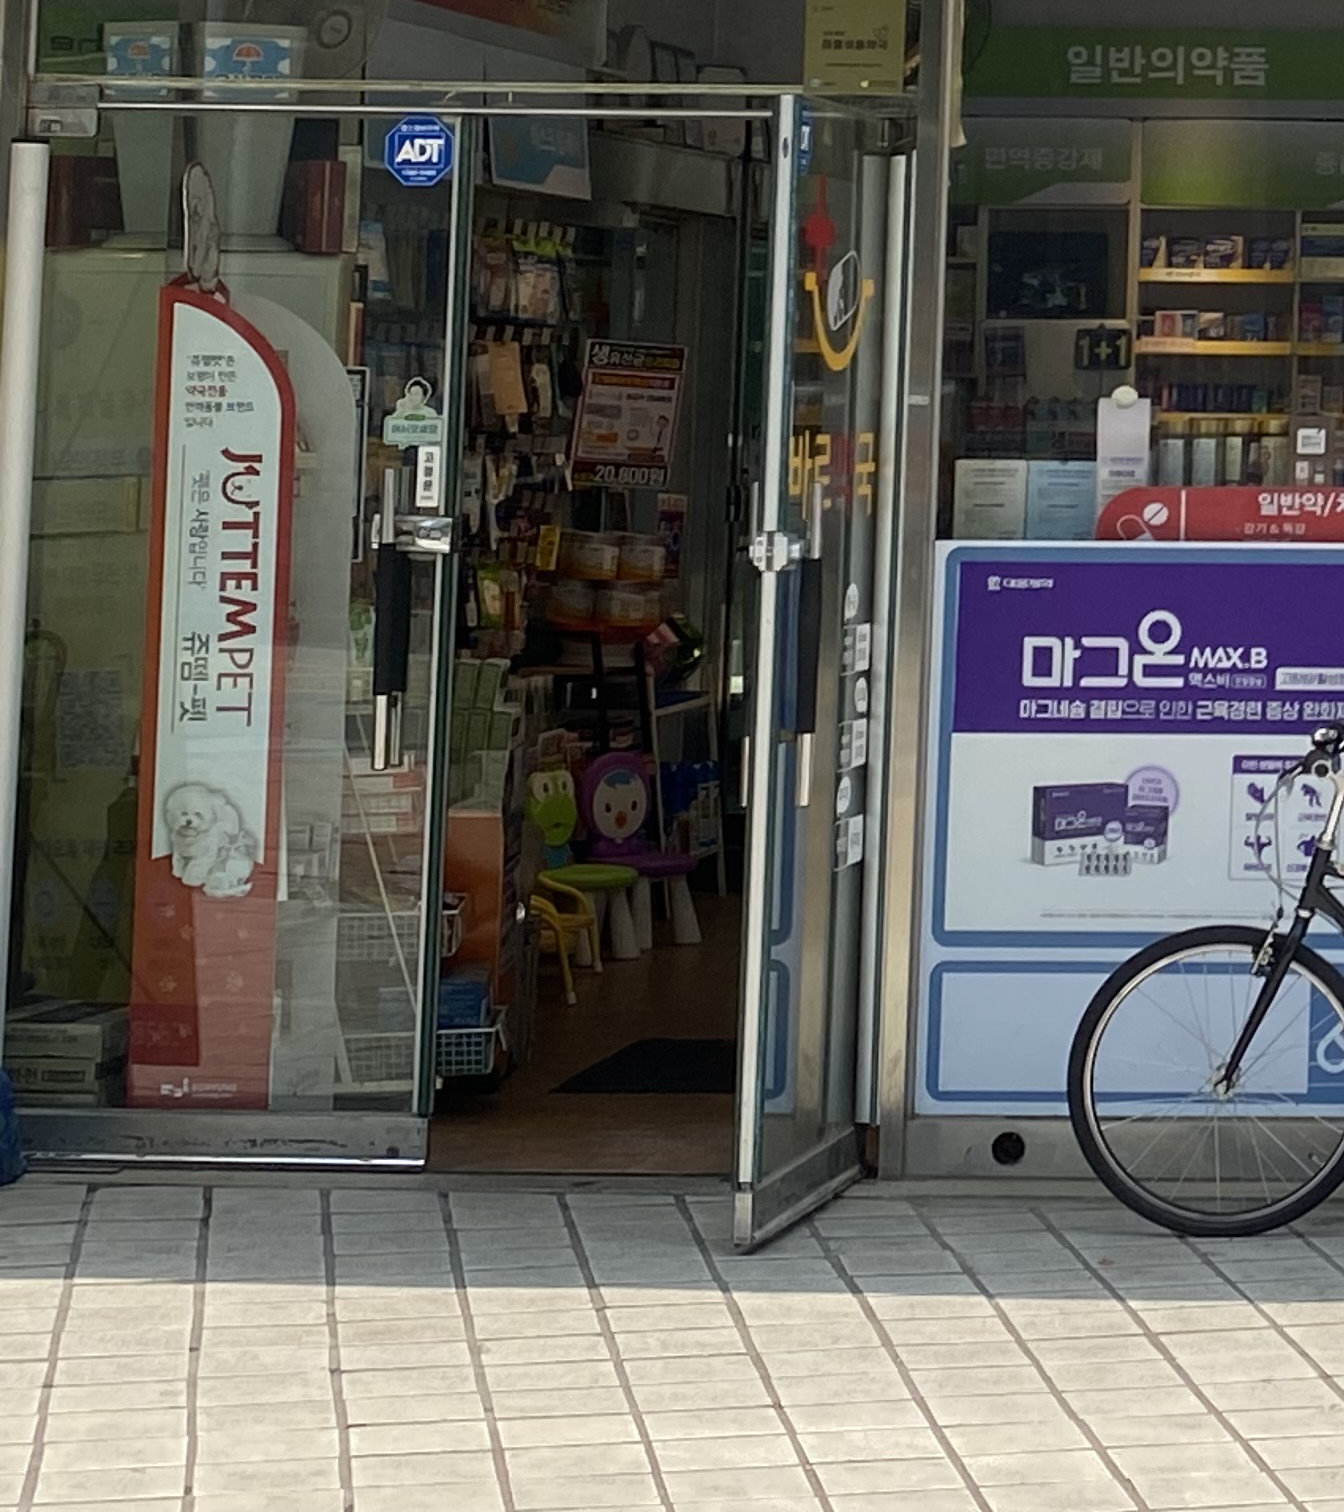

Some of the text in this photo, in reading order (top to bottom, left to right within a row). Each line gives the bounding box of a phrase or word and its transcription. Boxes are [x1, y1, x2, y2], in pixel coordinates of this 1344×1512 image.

[1067, 44, 1270, 87] 일반의약품
[395, 139, 445, 164] ADT
[1077, 334, 1130, 368] 1+1
[1022, 609, 1186, 688] 마그온
[1188, 672, 1231, 689] 맥스비
[1019, 700, 1086, 719] 마그네슘
[1088, 700, 1156, 719] 결핍으로
[1159, 701, 1193, 720] 인한
[1195, 701, 1262, 720] 근육경련
[1266, 701, 1300, 721] 증상
